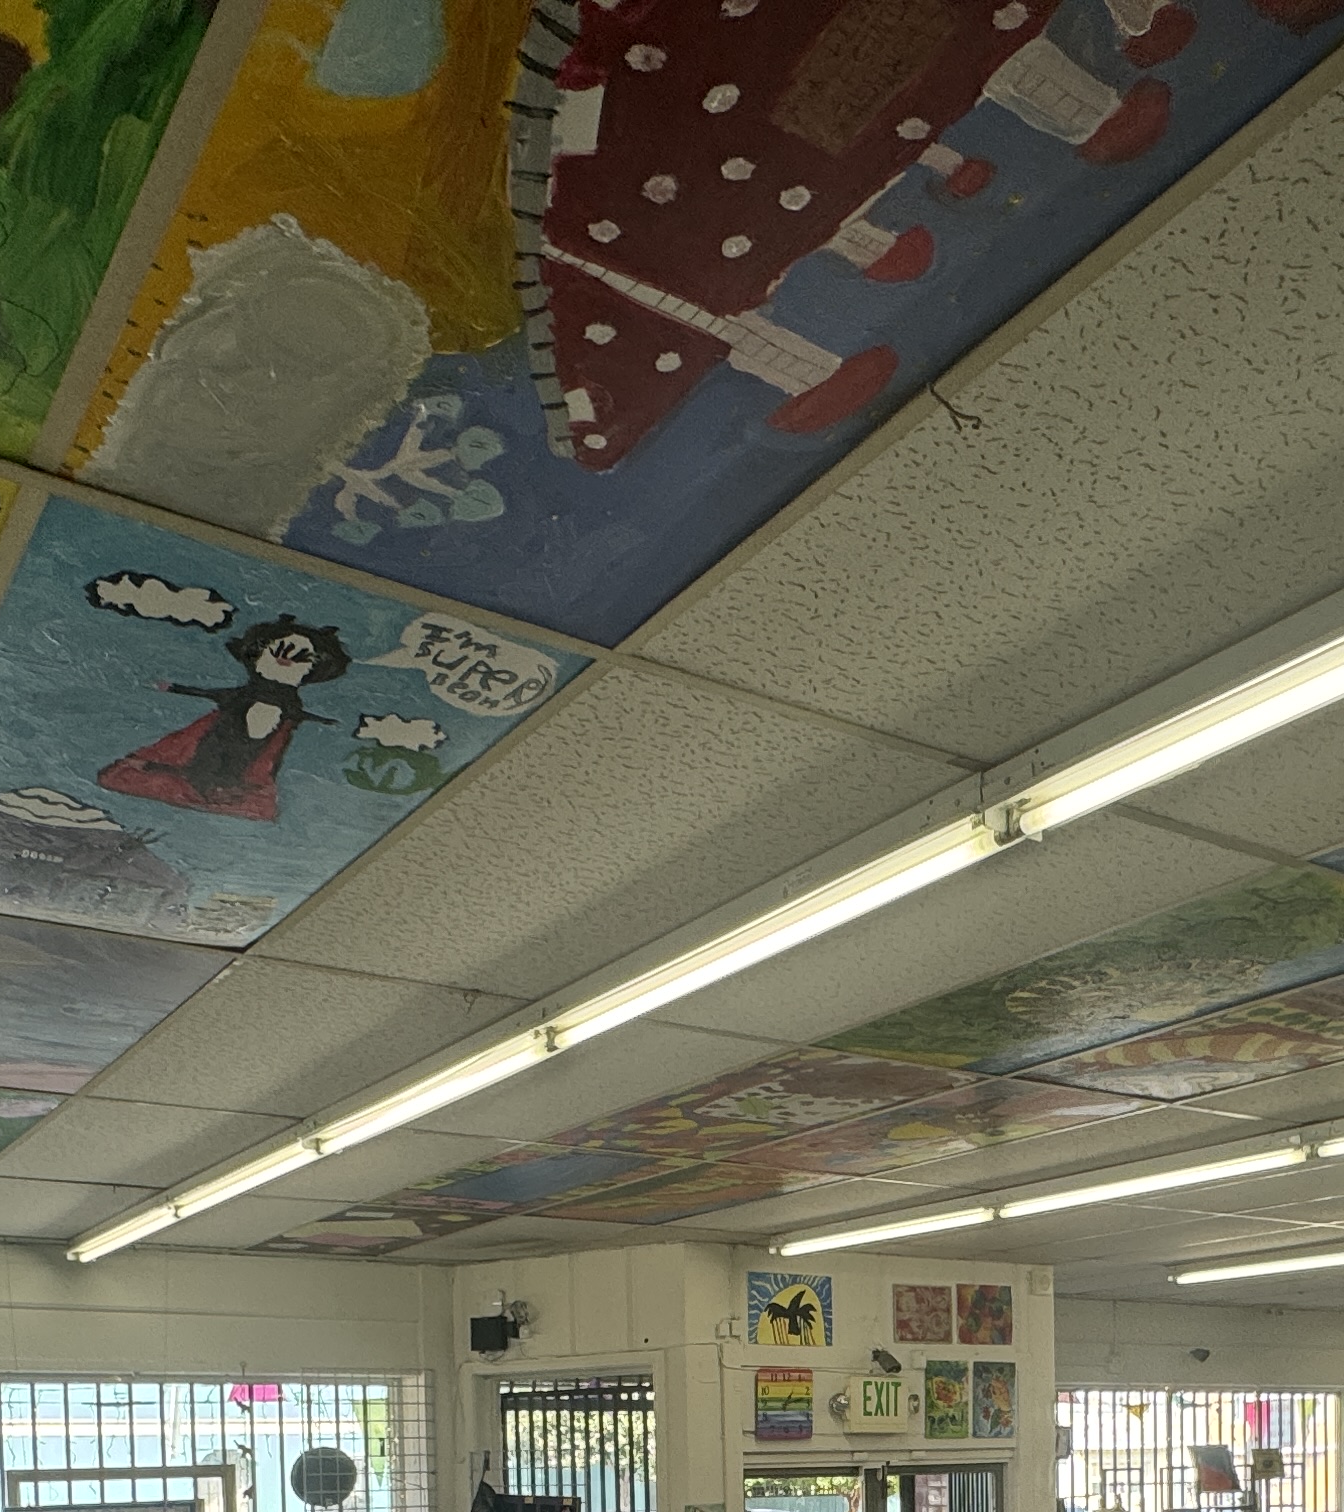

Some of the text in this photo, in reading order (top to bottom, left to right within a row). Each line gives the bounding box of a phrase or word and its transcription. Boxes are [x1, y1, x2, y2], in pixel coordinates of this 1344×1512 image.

[770, 1373, 778, 1382] 11
[782, 1373, 791, 1382] 12
[761, 1385, 811, 1396] 10 2
[862, 1380, 902, 1417] EXIT
